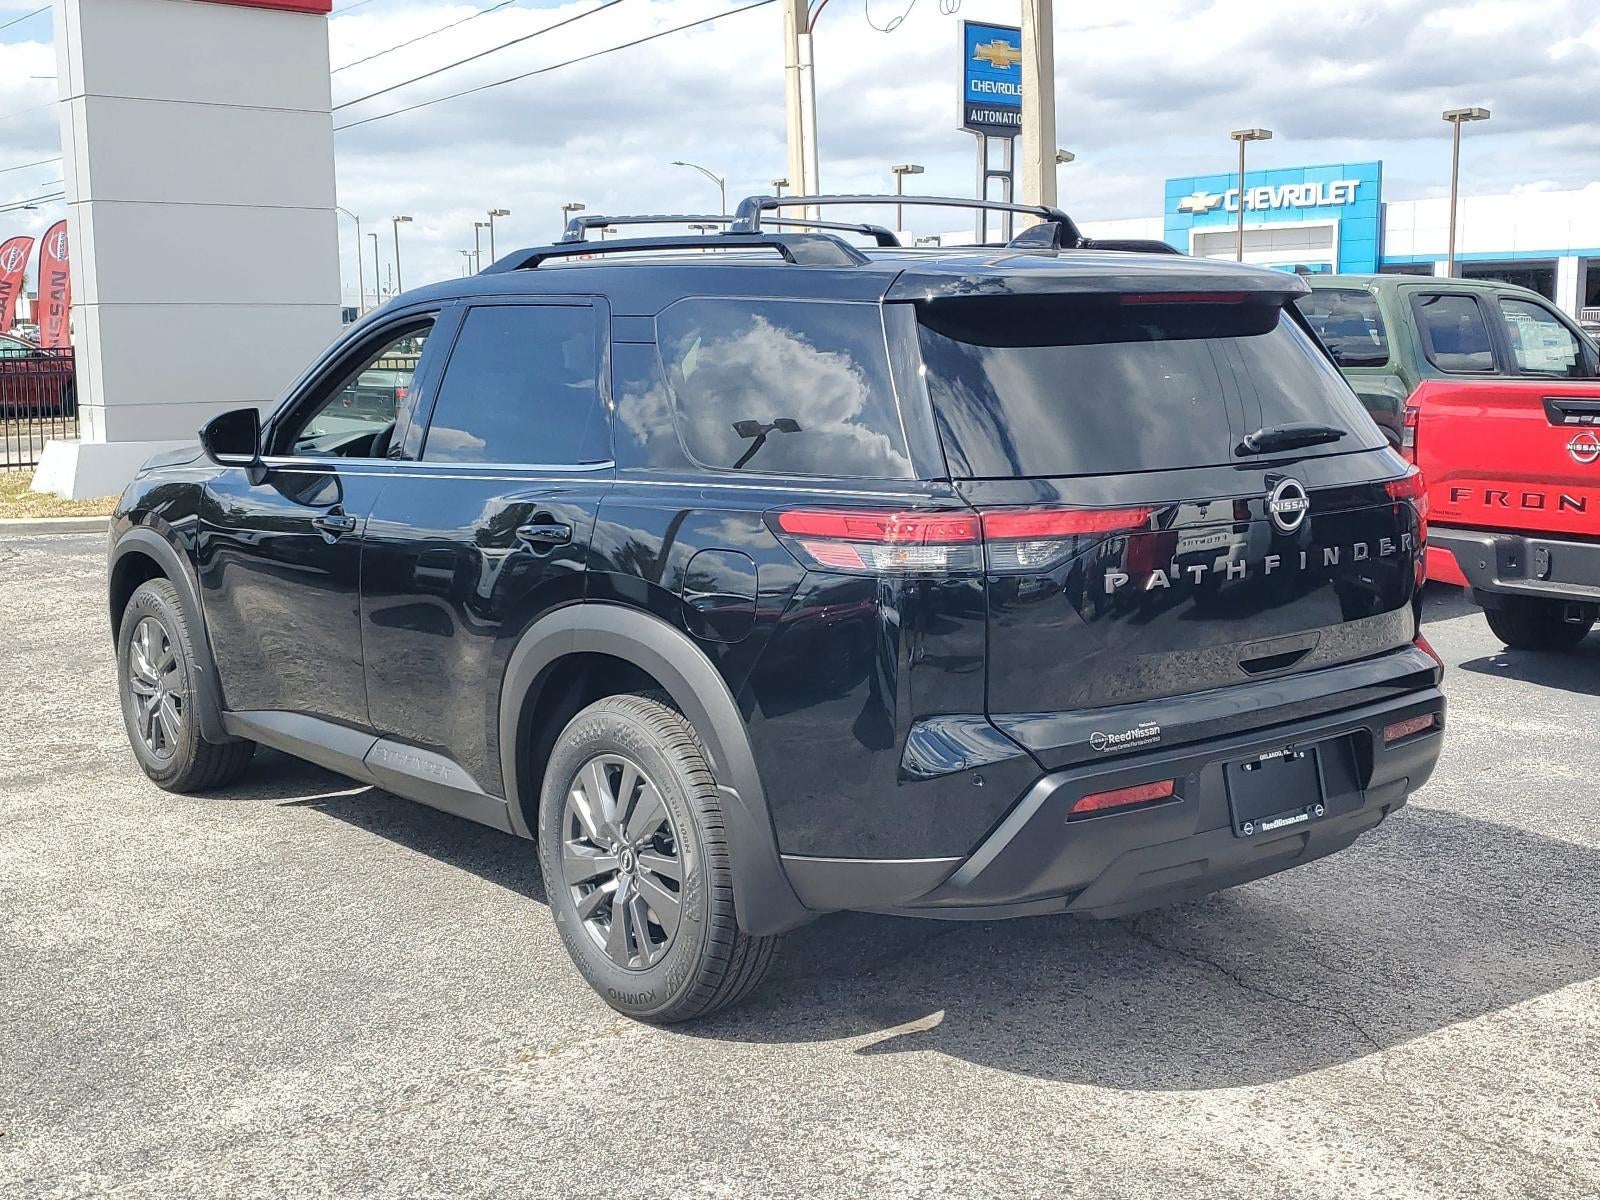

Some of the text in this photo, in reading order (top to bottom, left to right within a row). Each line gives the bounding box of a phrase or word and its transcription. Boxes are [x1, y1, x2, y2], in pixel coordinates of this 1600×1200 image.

[971, 79, 1022, 96] CHEVROLE
[971, 109, 1022, 124] AUTONATIO
[1224, 179, 1360, 212] CHEVROLET
[1567, 442, 1600, 451] NISSAN
[1270, 498, 1309, 512] NISSAN
[1450, 487, 1587, 513] FRON
[1104, 533, 1413, 594] PATHFINDER
[608, 988, 656, 1004] KUMHO
